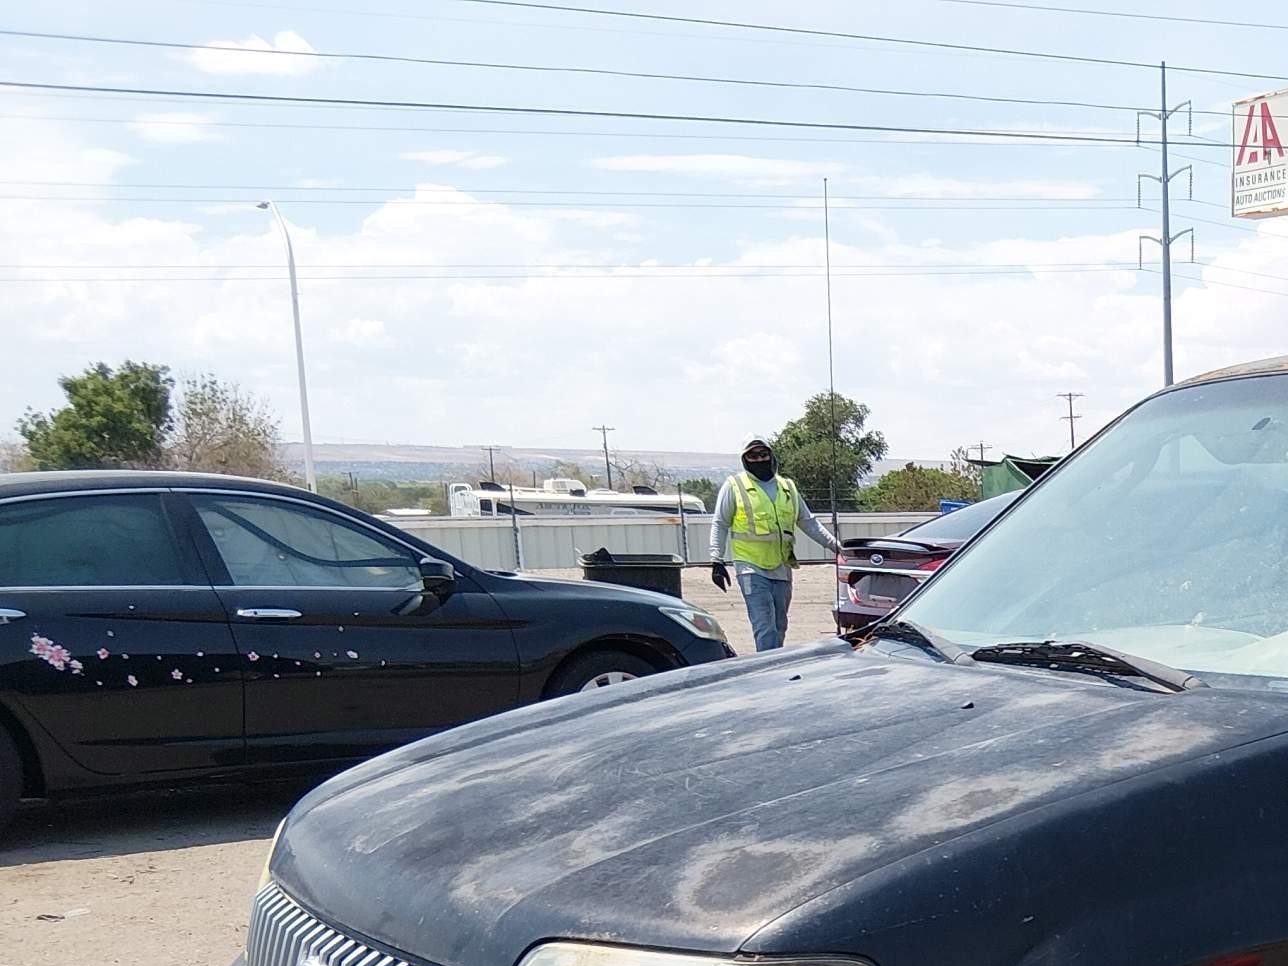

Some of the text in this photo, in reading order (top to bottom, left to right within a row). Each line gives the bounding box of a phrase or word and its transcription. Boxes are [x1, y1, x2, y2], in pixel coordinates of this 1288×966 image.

[1235, 168, 1287, 188] INSURANCE
[1235, 193, 1253, 206] AUTO
[1254, 187, 1287, 203] AUCTIONS
